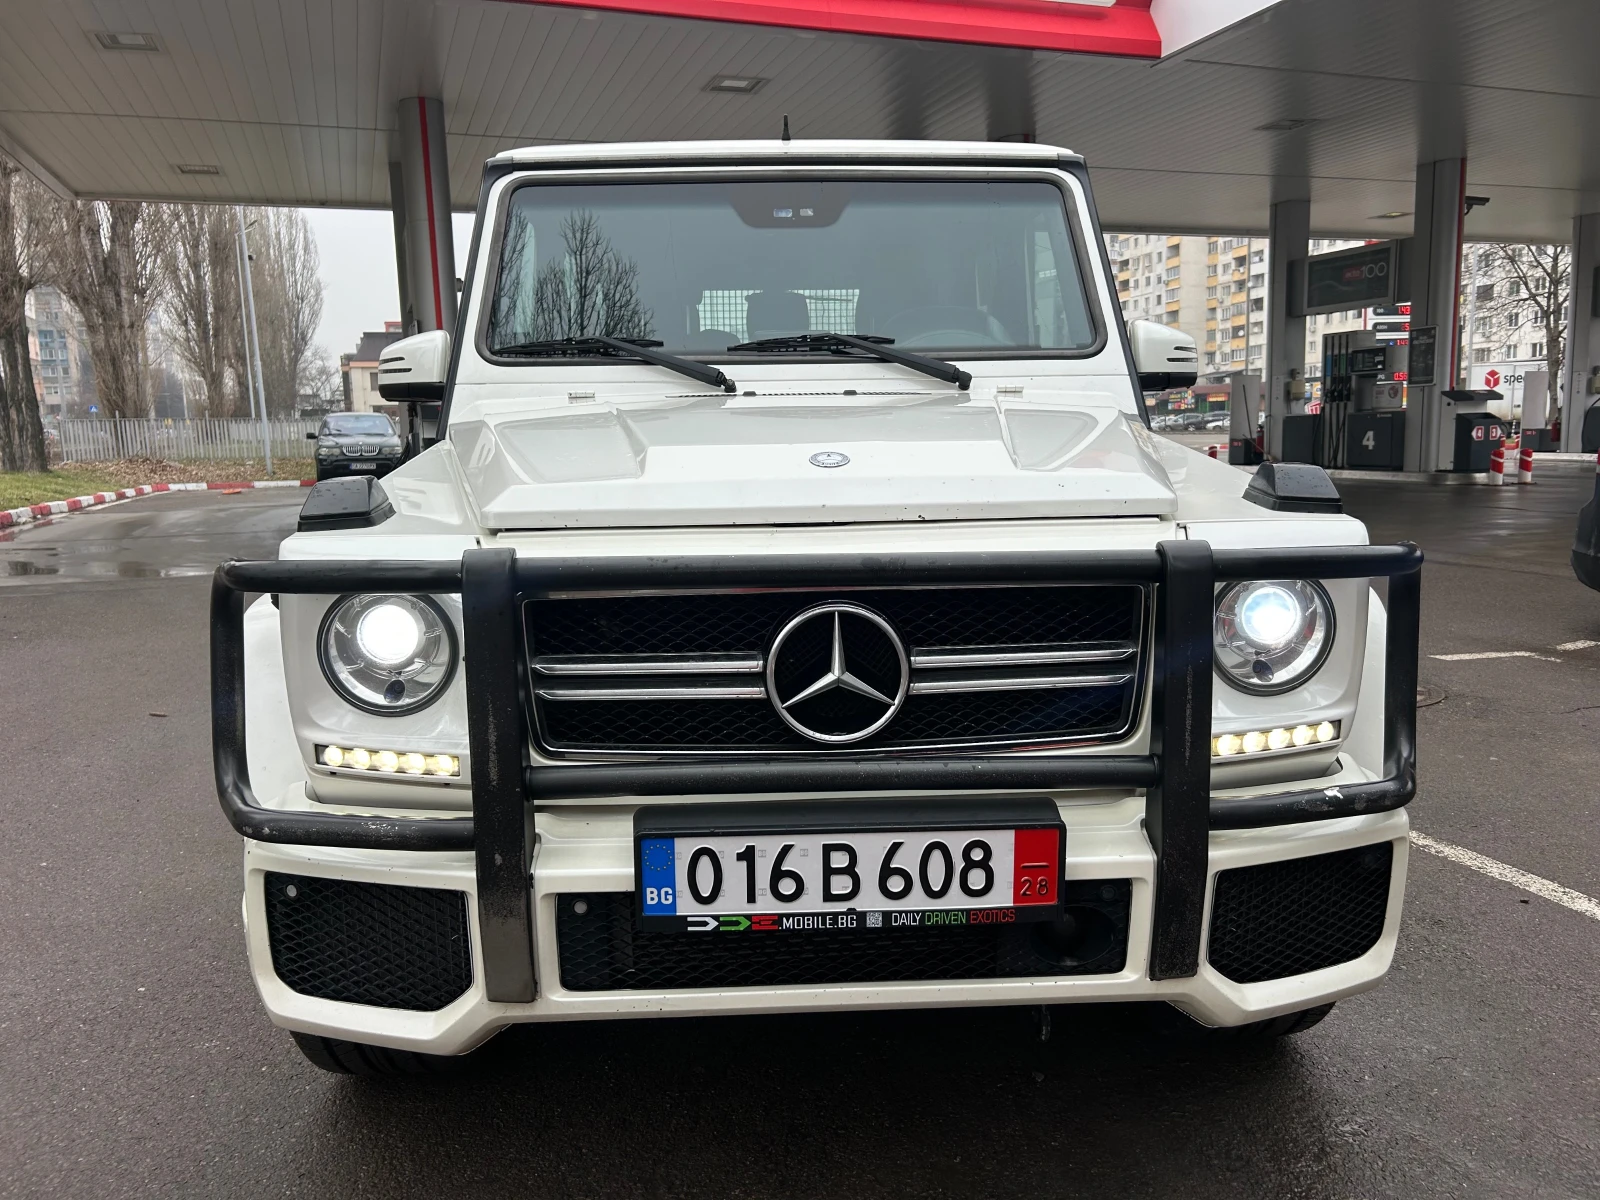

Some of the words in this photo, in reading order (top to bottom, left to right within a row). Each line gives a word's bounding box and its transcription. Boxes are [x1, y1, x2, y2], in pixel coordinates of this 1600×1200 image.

[1362, 430, 1375, 450] 4
[687, 842, 806, 905] 016
[822, 842, 862, 903] B
[878, 838, 995, 901] 608
[646, 887, 673, 905] BG
[1019, 876, 1050, 897] 28
[892, 912, 922, 926] DAILY
[925, 911, 967, 925] DRIVEN
[970, 909, 1016, 923] EXOTICS
